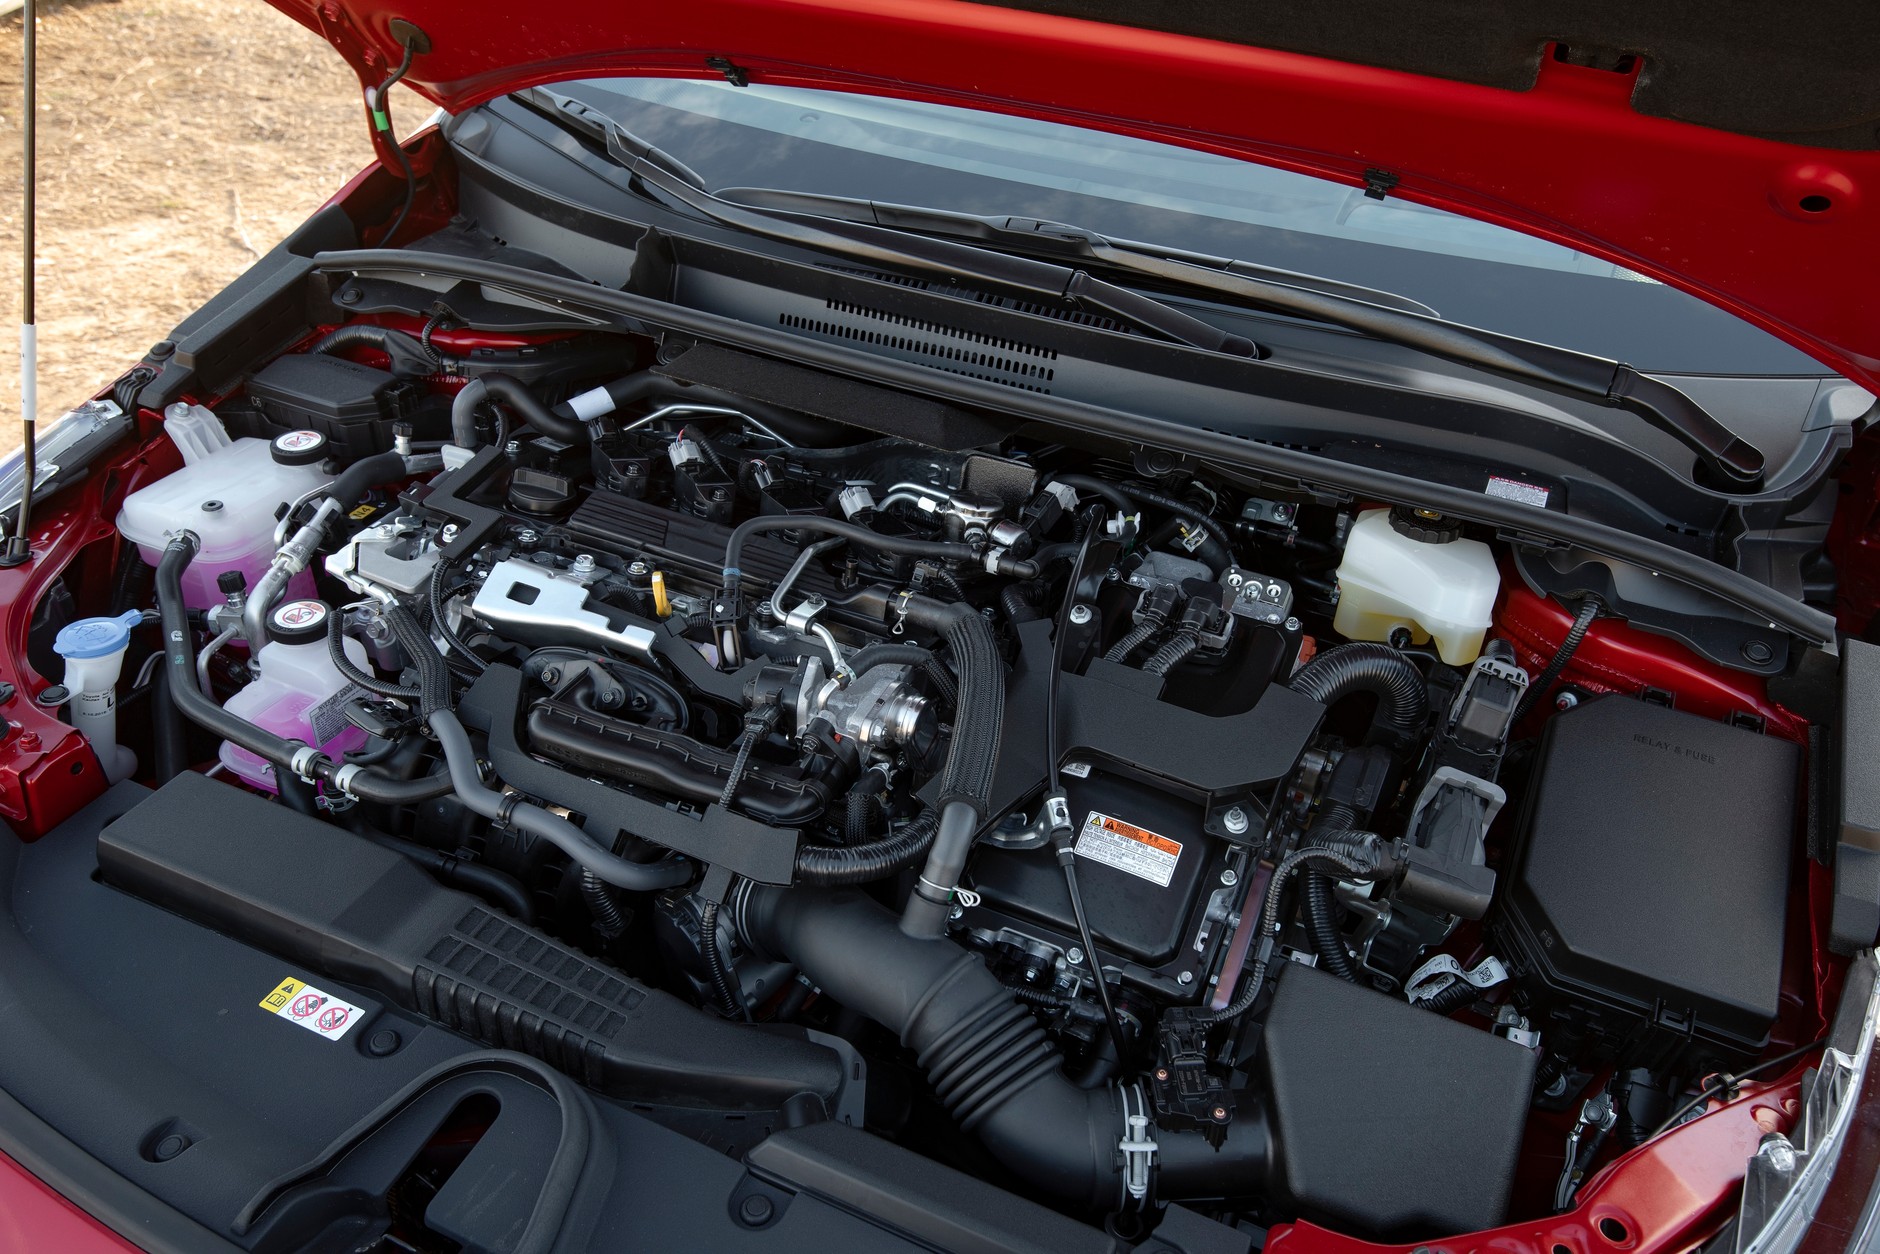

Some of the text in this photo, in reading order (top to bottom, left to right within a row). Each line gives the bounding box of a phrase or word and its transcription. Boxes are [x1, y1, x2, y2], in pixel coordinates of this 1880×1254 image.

[1633, 733, 1717, 765] RELAY & FUSE
[1116, 821, 1140, 834] WARNING
